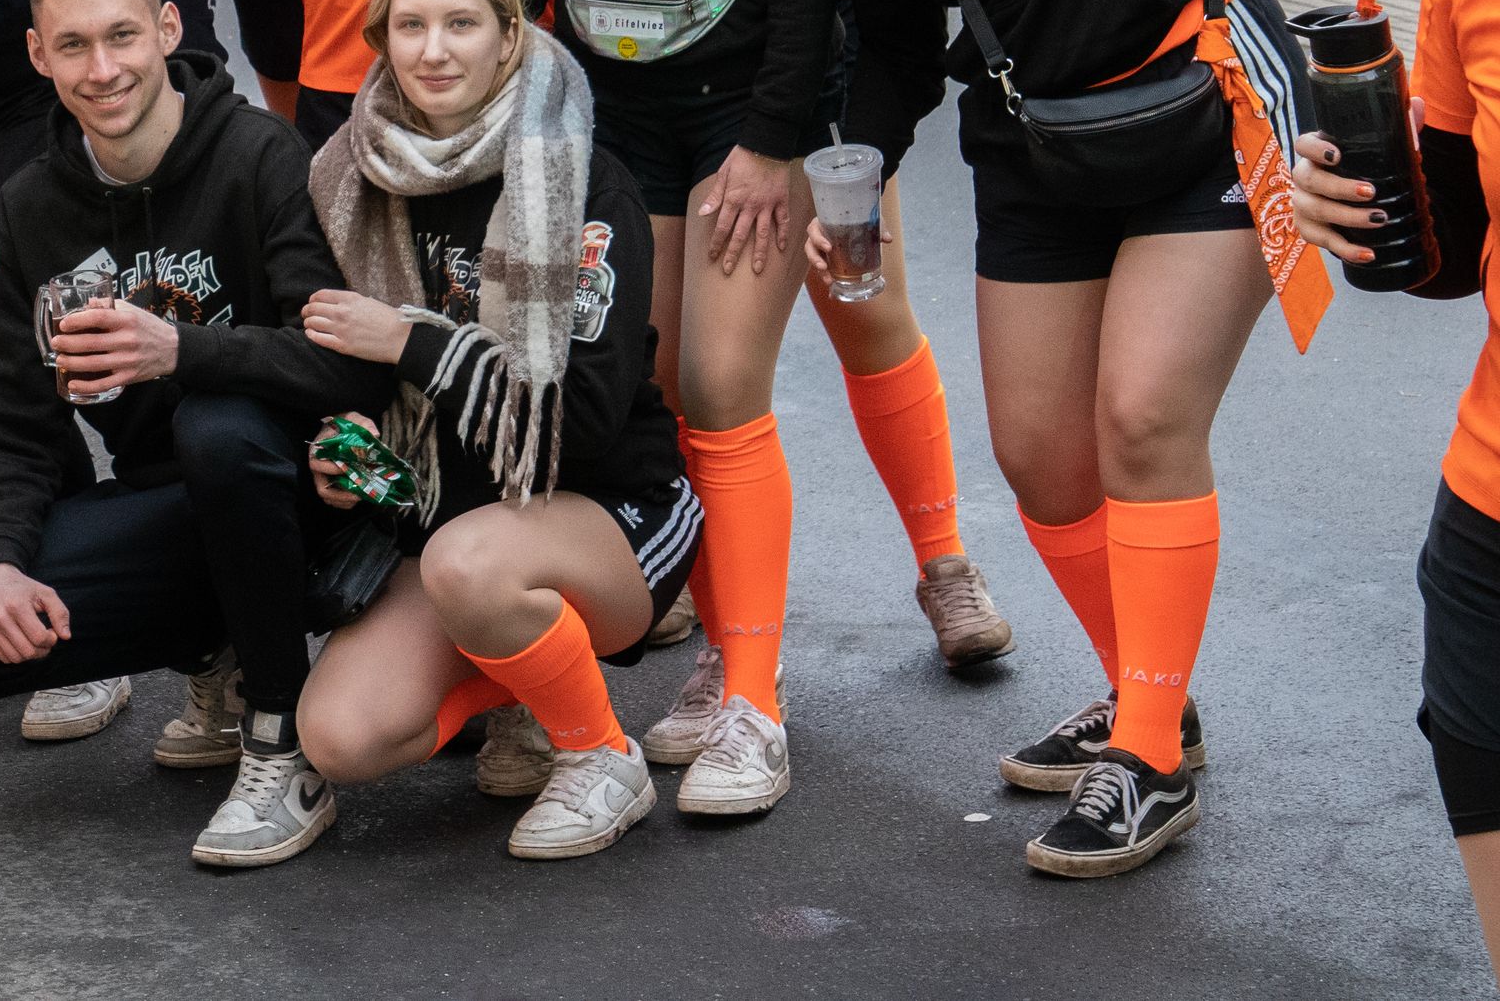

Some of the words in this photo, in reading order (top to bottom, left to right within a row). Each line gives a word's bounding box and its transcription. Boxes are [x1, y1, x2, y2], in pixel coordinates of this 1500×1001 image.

[615, 18, 663, 30] Eifelviez
[1221, 193, 1247, 203] adid
[575, 289, 600, 304] CKEN
[723, 622, 778, 636] JAKO
[1123, 666, 1182, 687] JAKO
